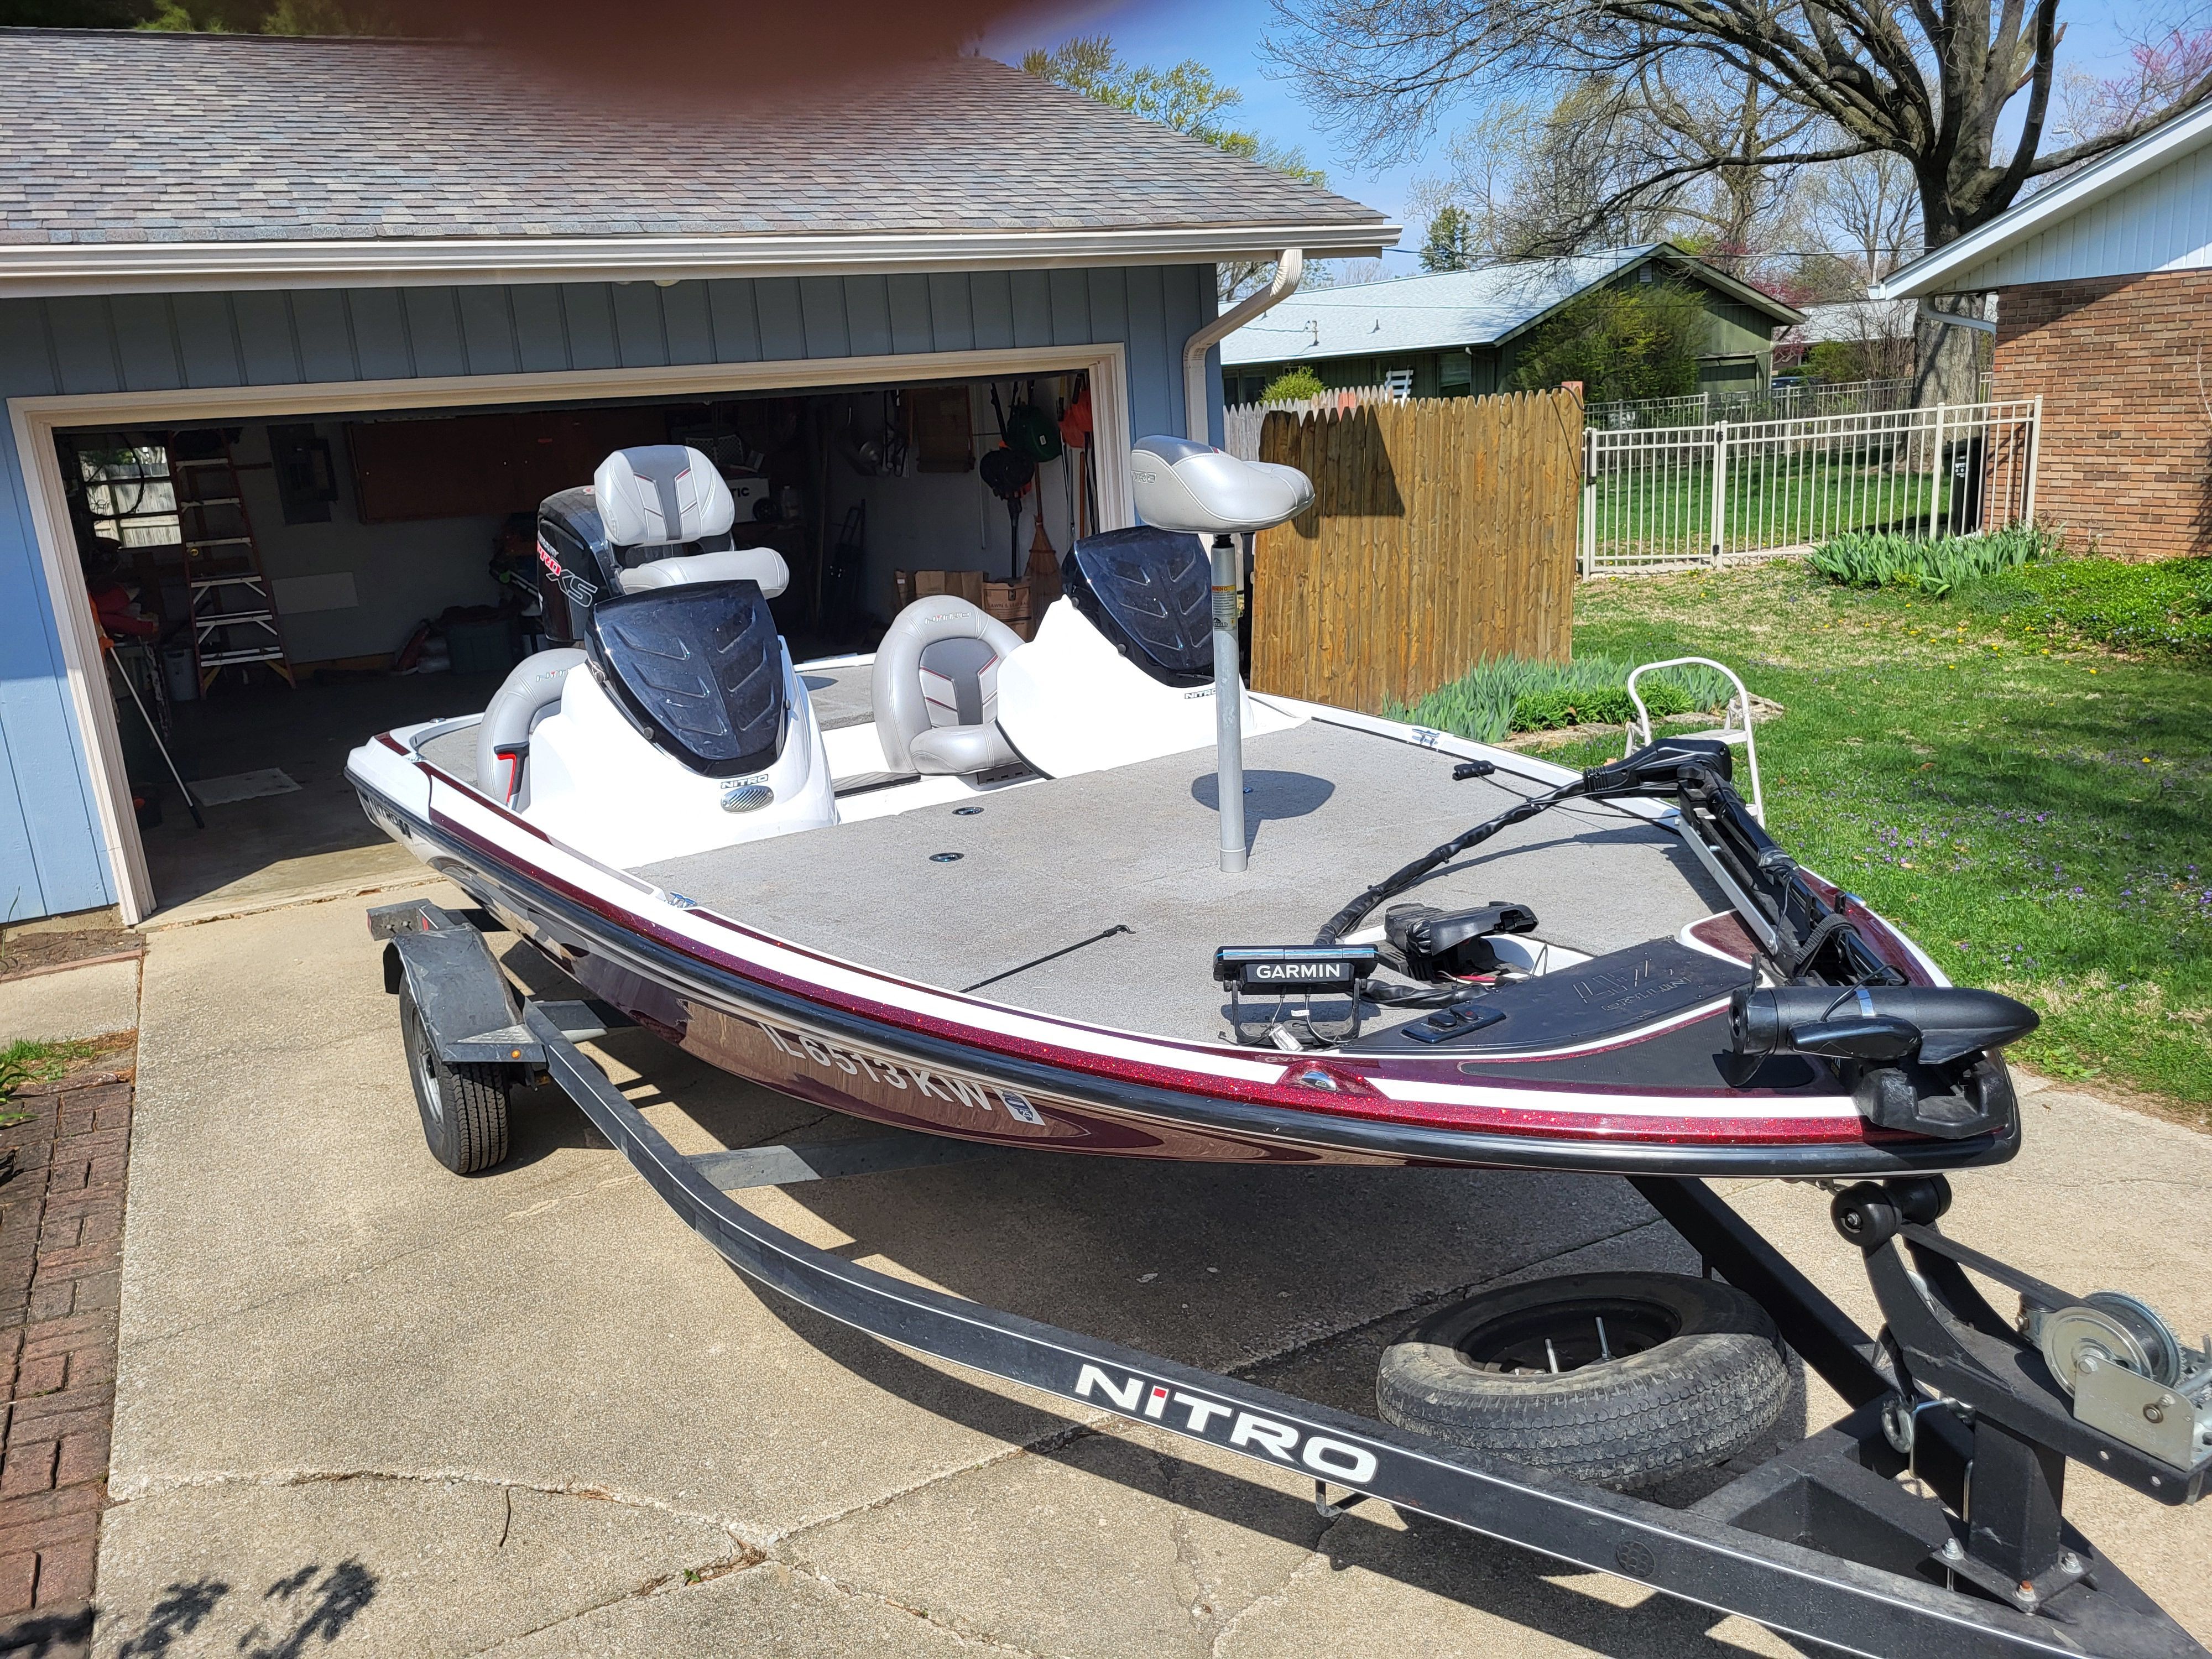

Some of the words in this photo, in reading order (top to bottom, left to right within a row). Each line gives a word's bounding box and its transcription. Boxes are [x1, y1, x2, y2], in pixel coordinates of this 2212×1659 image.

[546, 568, 598, 608] XS
[721, 774, 769, 789] NITRO
[1256, 964, 1340, 978] GARMIN
[1020, 1109, 1032, 1118] 25
[1074, 1363, 1378, 1484] NITRO
